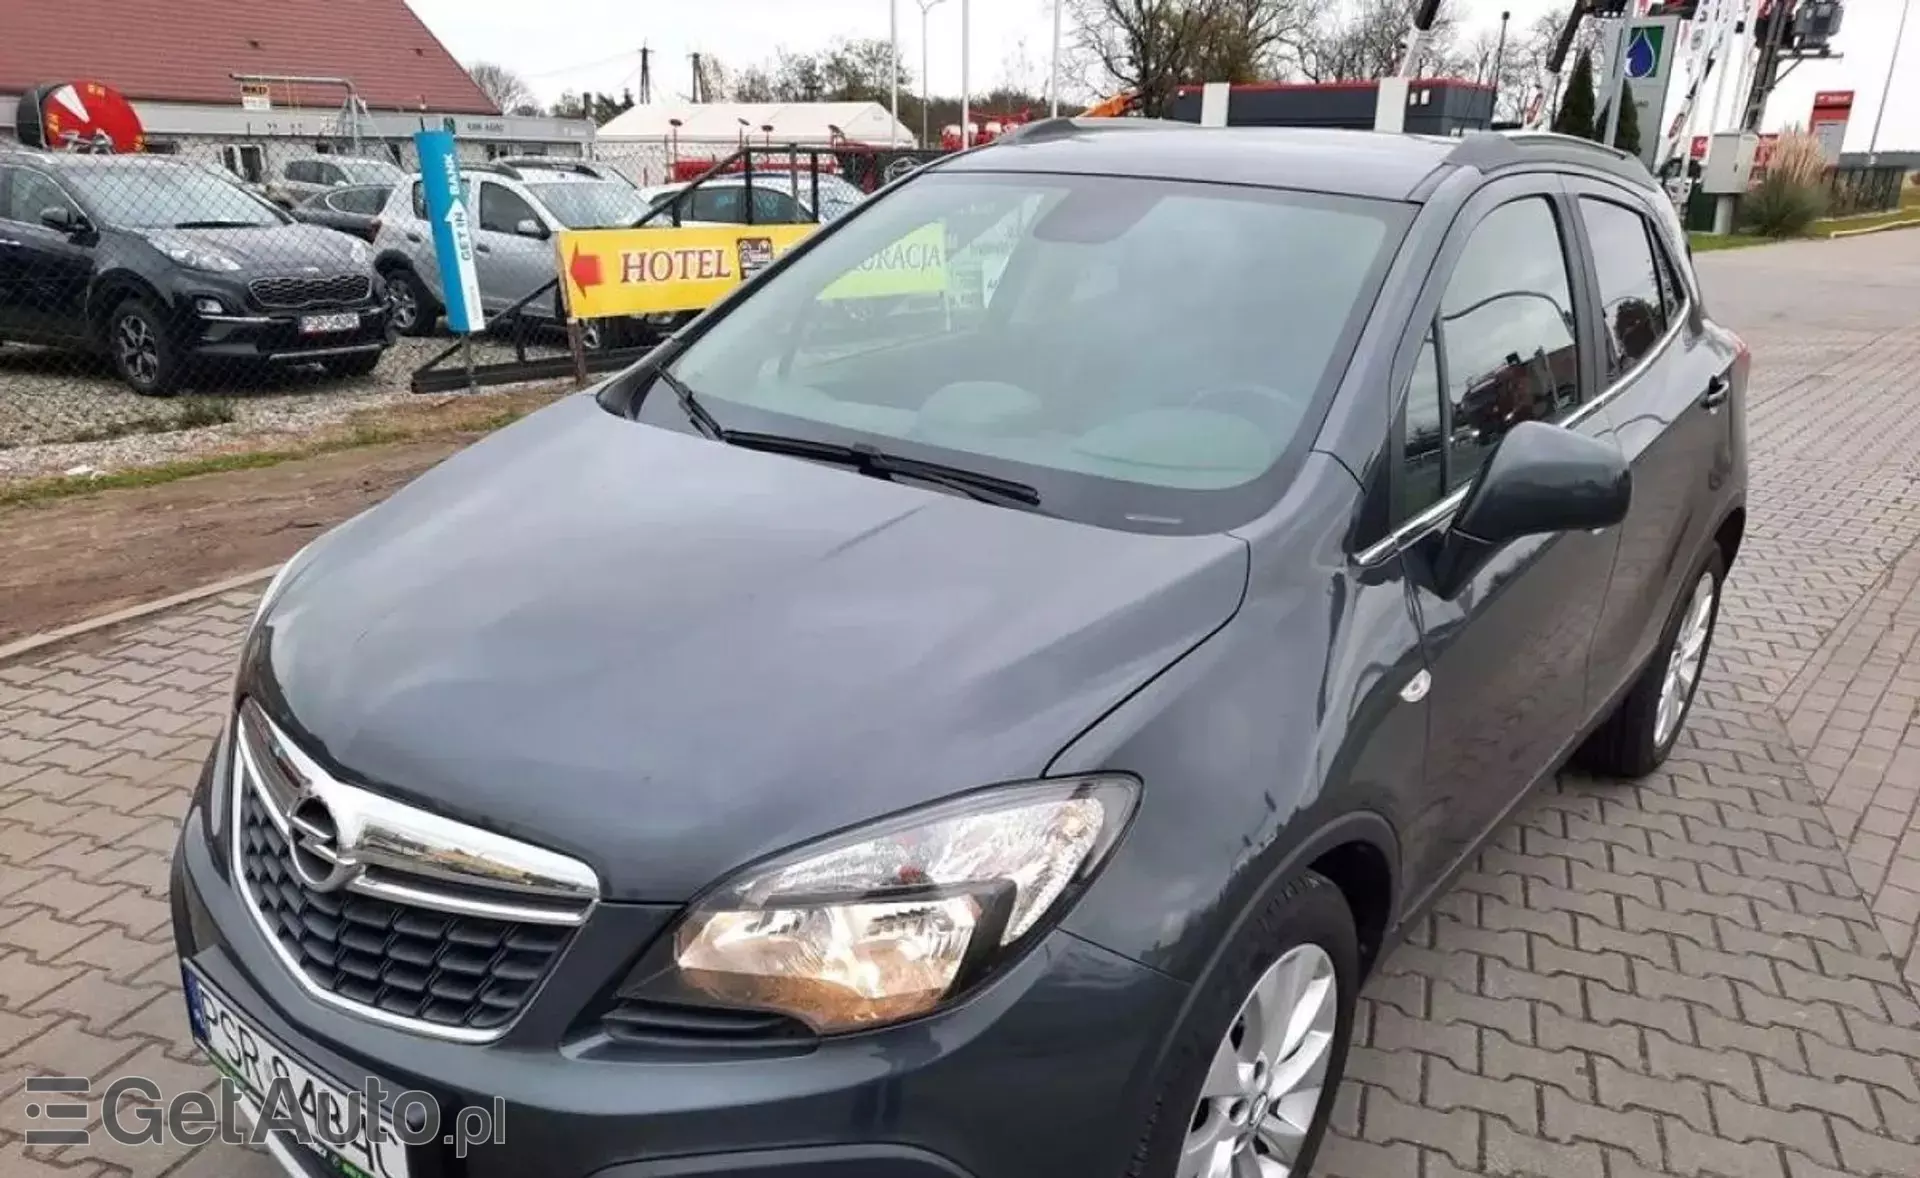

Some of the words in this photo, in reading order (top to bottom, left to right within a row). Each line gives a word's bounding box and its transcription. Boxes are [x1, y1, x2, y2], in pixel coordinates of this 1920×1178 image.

[443, 153, 460, 196] BANK
[620, 249, 732, 283] HOTEL
[202, 991, 265, 1091] PSR
